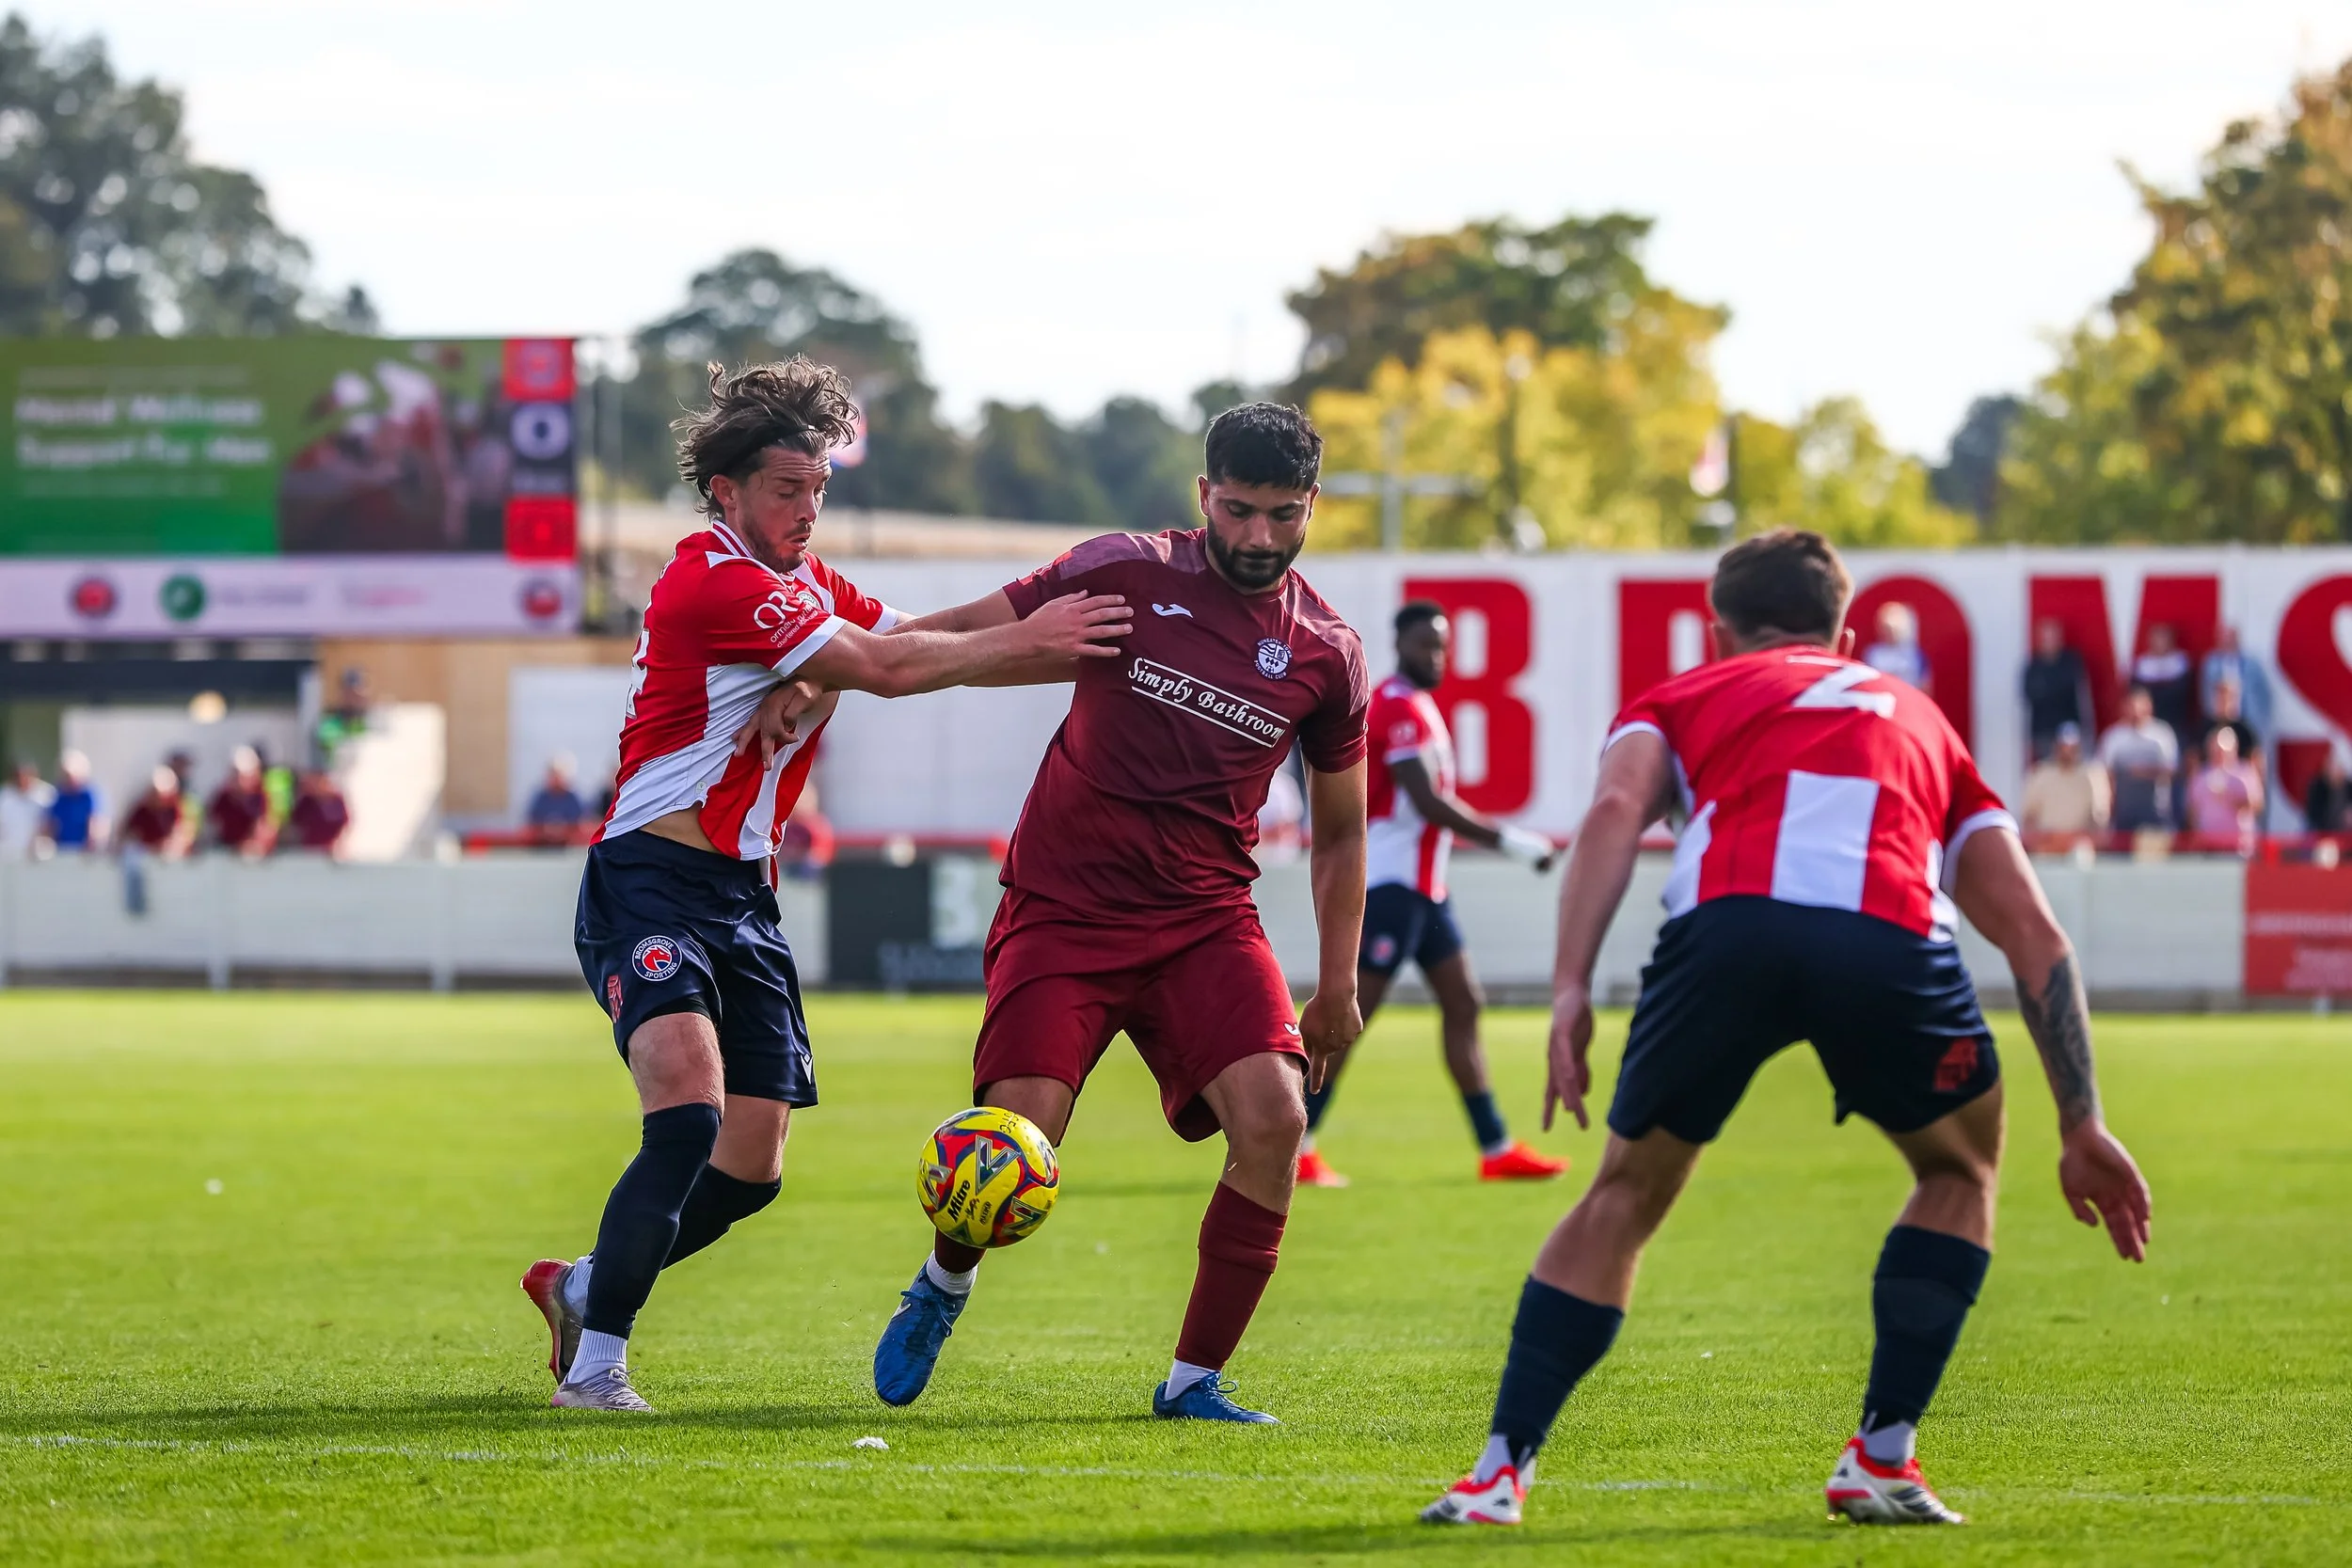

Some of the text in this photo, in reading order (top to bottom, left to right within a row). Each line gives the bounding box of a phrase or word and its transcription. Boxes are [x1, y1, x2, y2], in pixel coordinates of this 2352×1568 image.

[1128, 657, 1193, 703] Simply
[1786, 655, 1897, 719] 2
[635, 939, 674, 959] BROMSGROVE
[644, 962, 677, 978] SPORTING
[947, 1180, 971, 1224] Mitre
